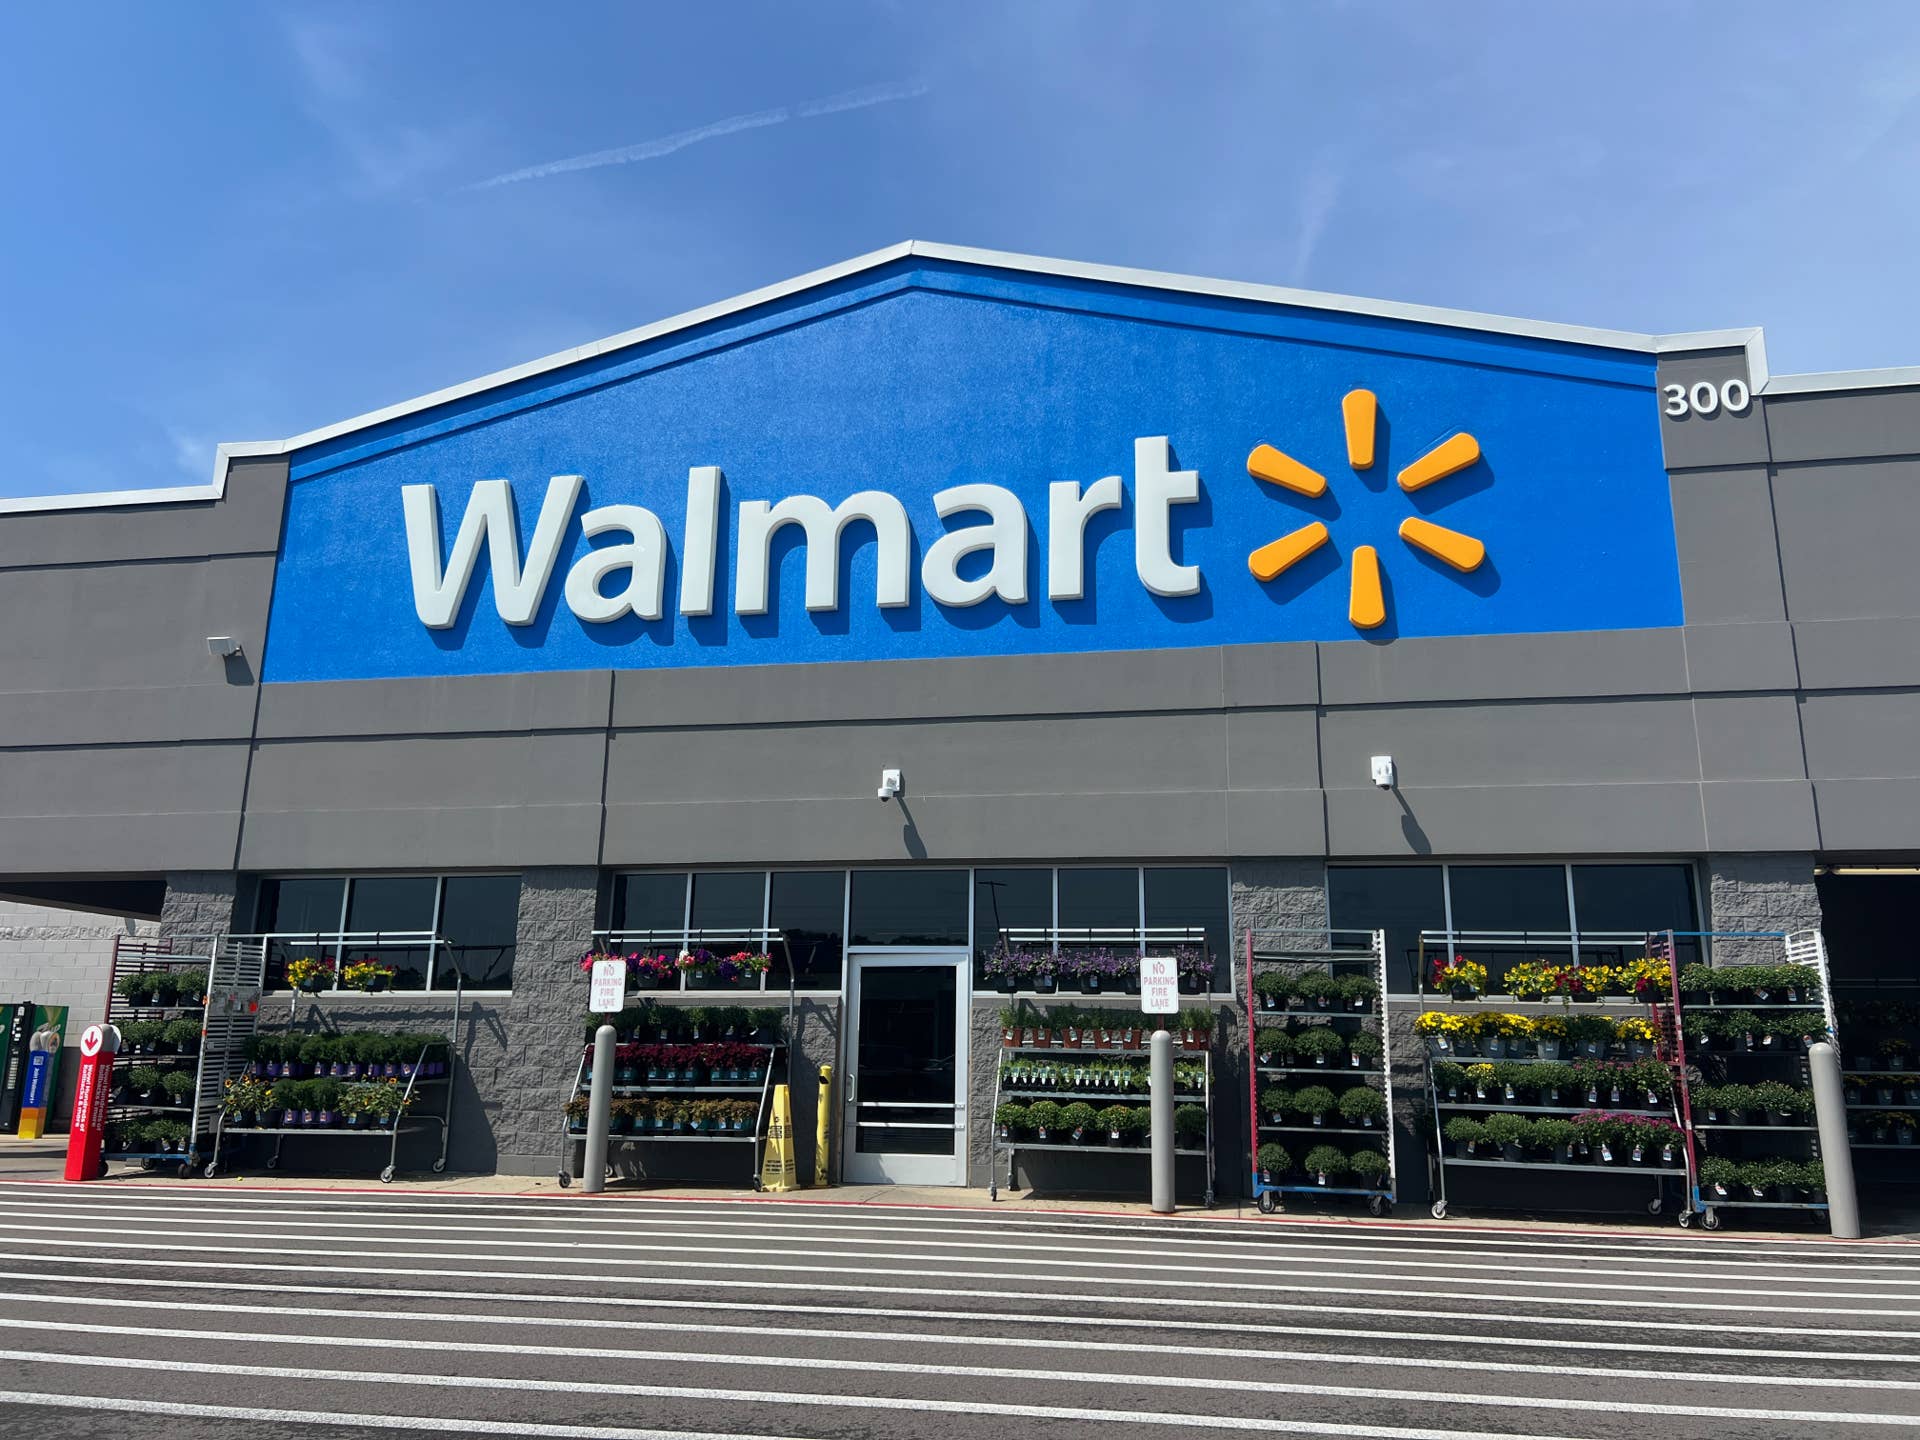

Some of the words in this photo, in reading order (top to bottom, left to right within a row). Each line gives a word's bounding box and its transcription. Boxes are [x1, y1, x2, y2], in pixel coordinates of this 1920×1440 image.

[1663, 379, 1750, 416] 300
[401, 436, 1201, 630] Walmart
[603, 966, 615, 976] NO
[1152, 963, 1165, 975] NO
[593, 977, 623, 986] PARKING
[1143, 976, 1175, 986] PARKING
[600, 987, 615, 996] FIRE
[1151, 987, 1168, 996] FIRE
[598, 998, 615, 1007] LANE
[1150, 998, 1169, 1007] LANE
[85, 1064, 94, 1084] Wow!
[102, 1064, 111, 1084] Wow!
[78, 1064, 89, 1100] Rollbacks
[95, 1064, 106, 1100] Rollbacks
[80, 1085, 91, 1123] Hundreds
[97, 1085, 108, 1123] Hundreds
[79, 1123, 85, 1132] of
